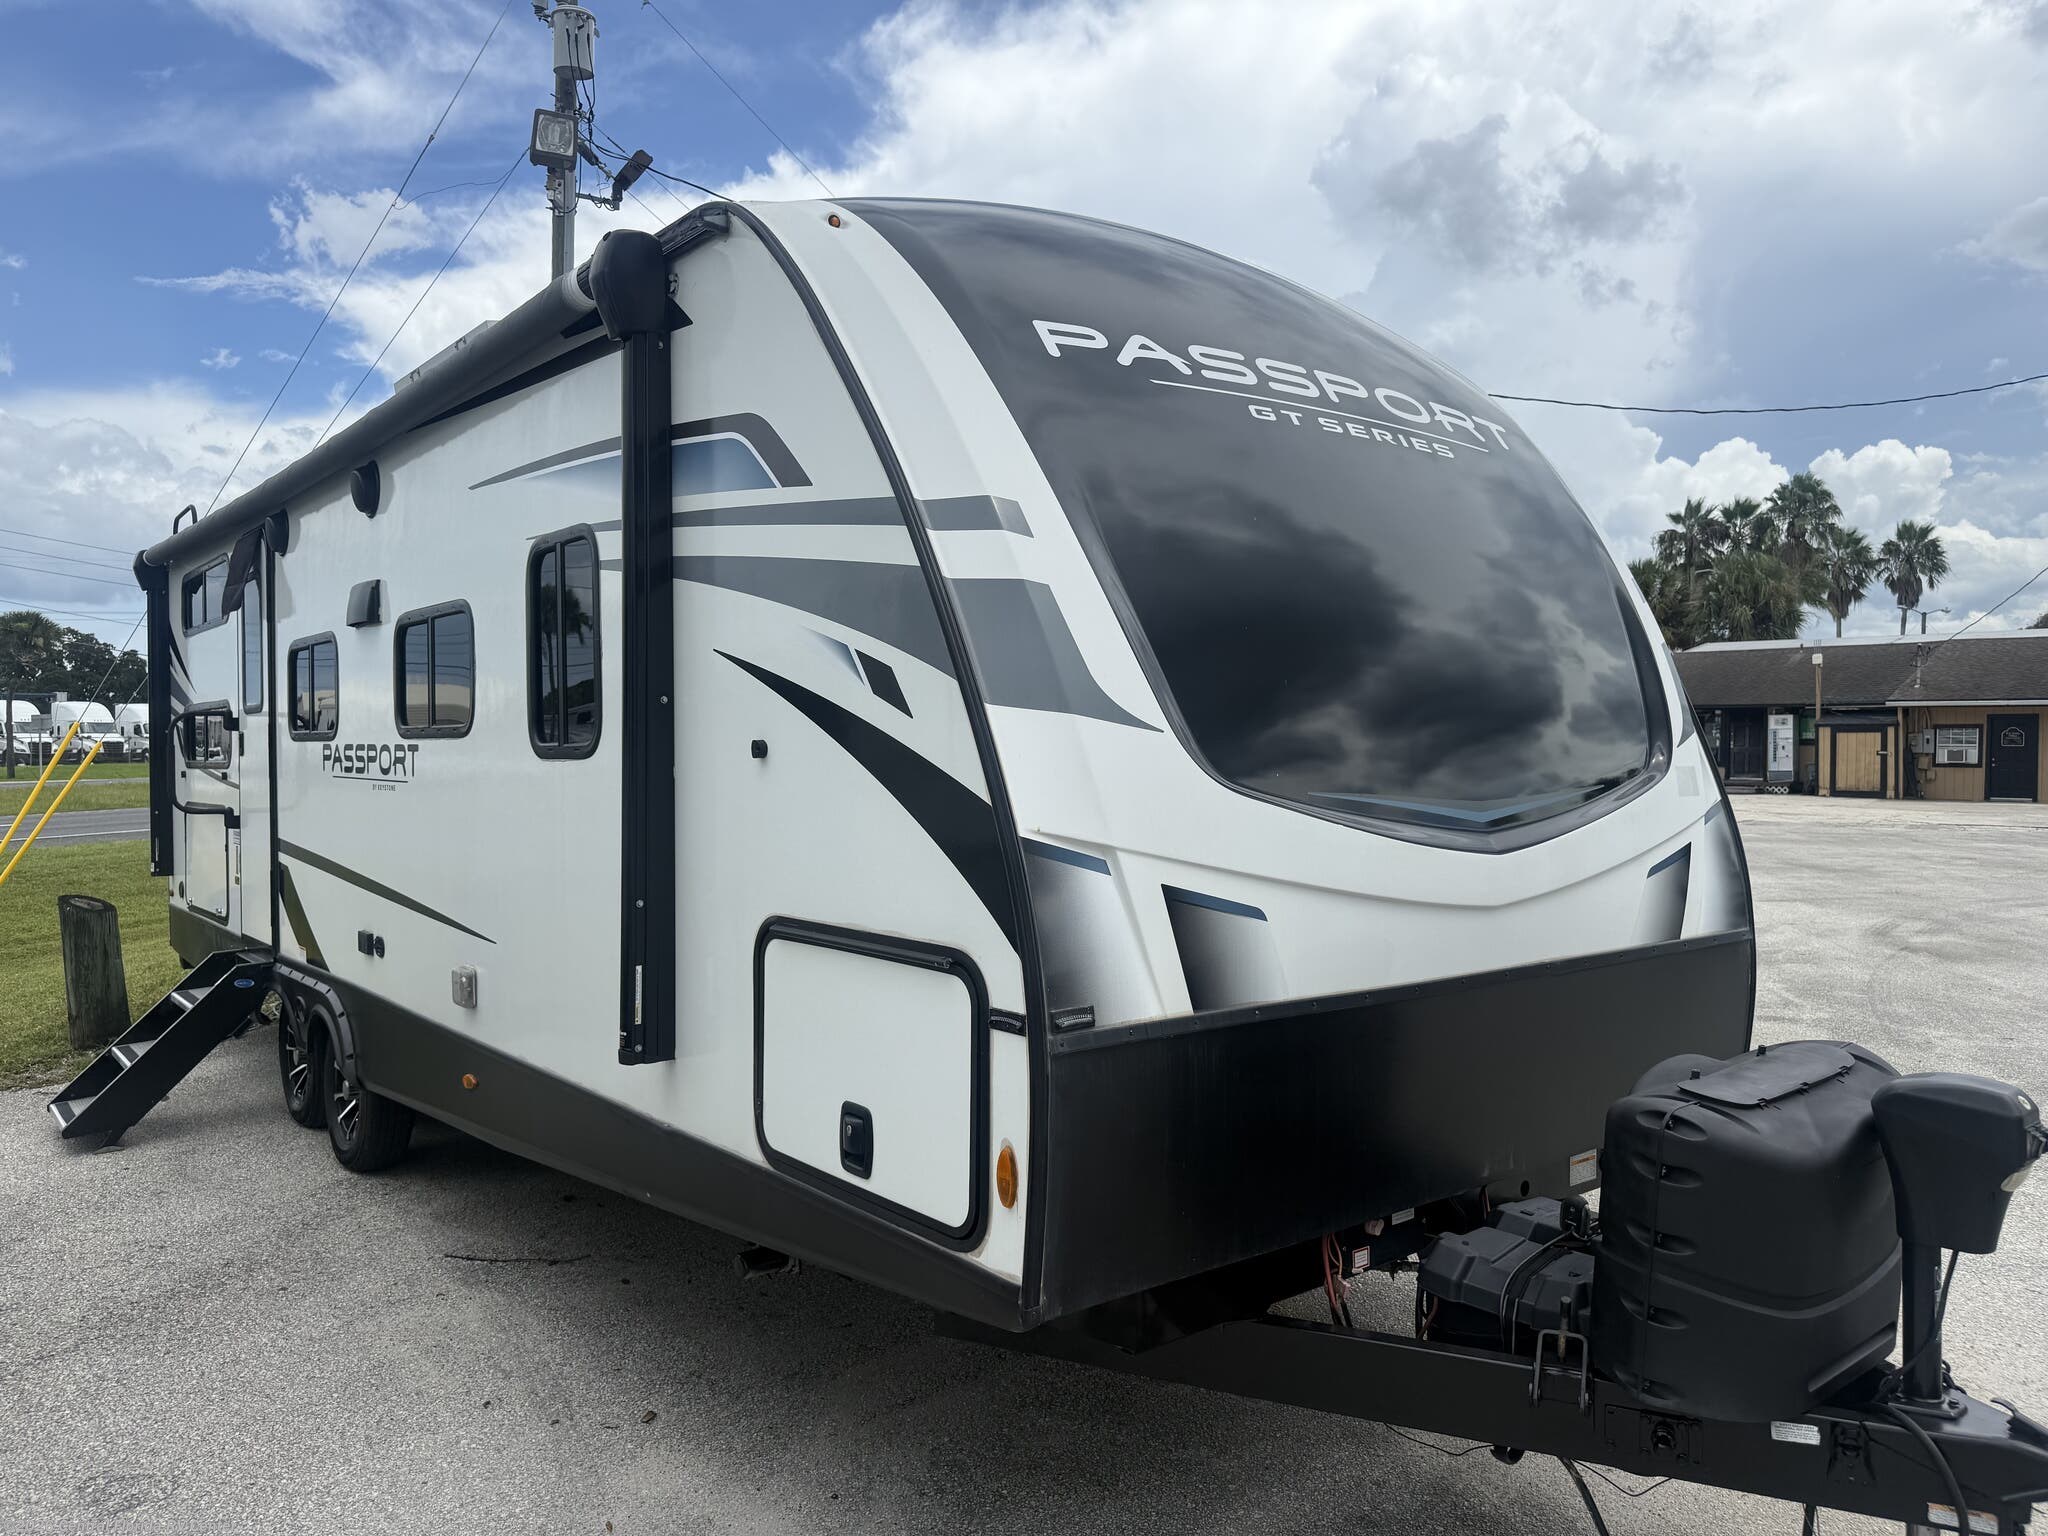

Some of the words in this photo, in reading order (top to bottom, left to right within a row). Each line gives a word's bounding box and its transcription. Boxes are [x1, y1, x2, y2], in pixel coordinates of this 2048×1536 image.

[1032, 319, 1509, 450] PASSPORT
[1247, 405, 1304, 426] GT
[1319, 418, 1455, 459] SERIES
[322, 744, 419, 777] PASSPORT
